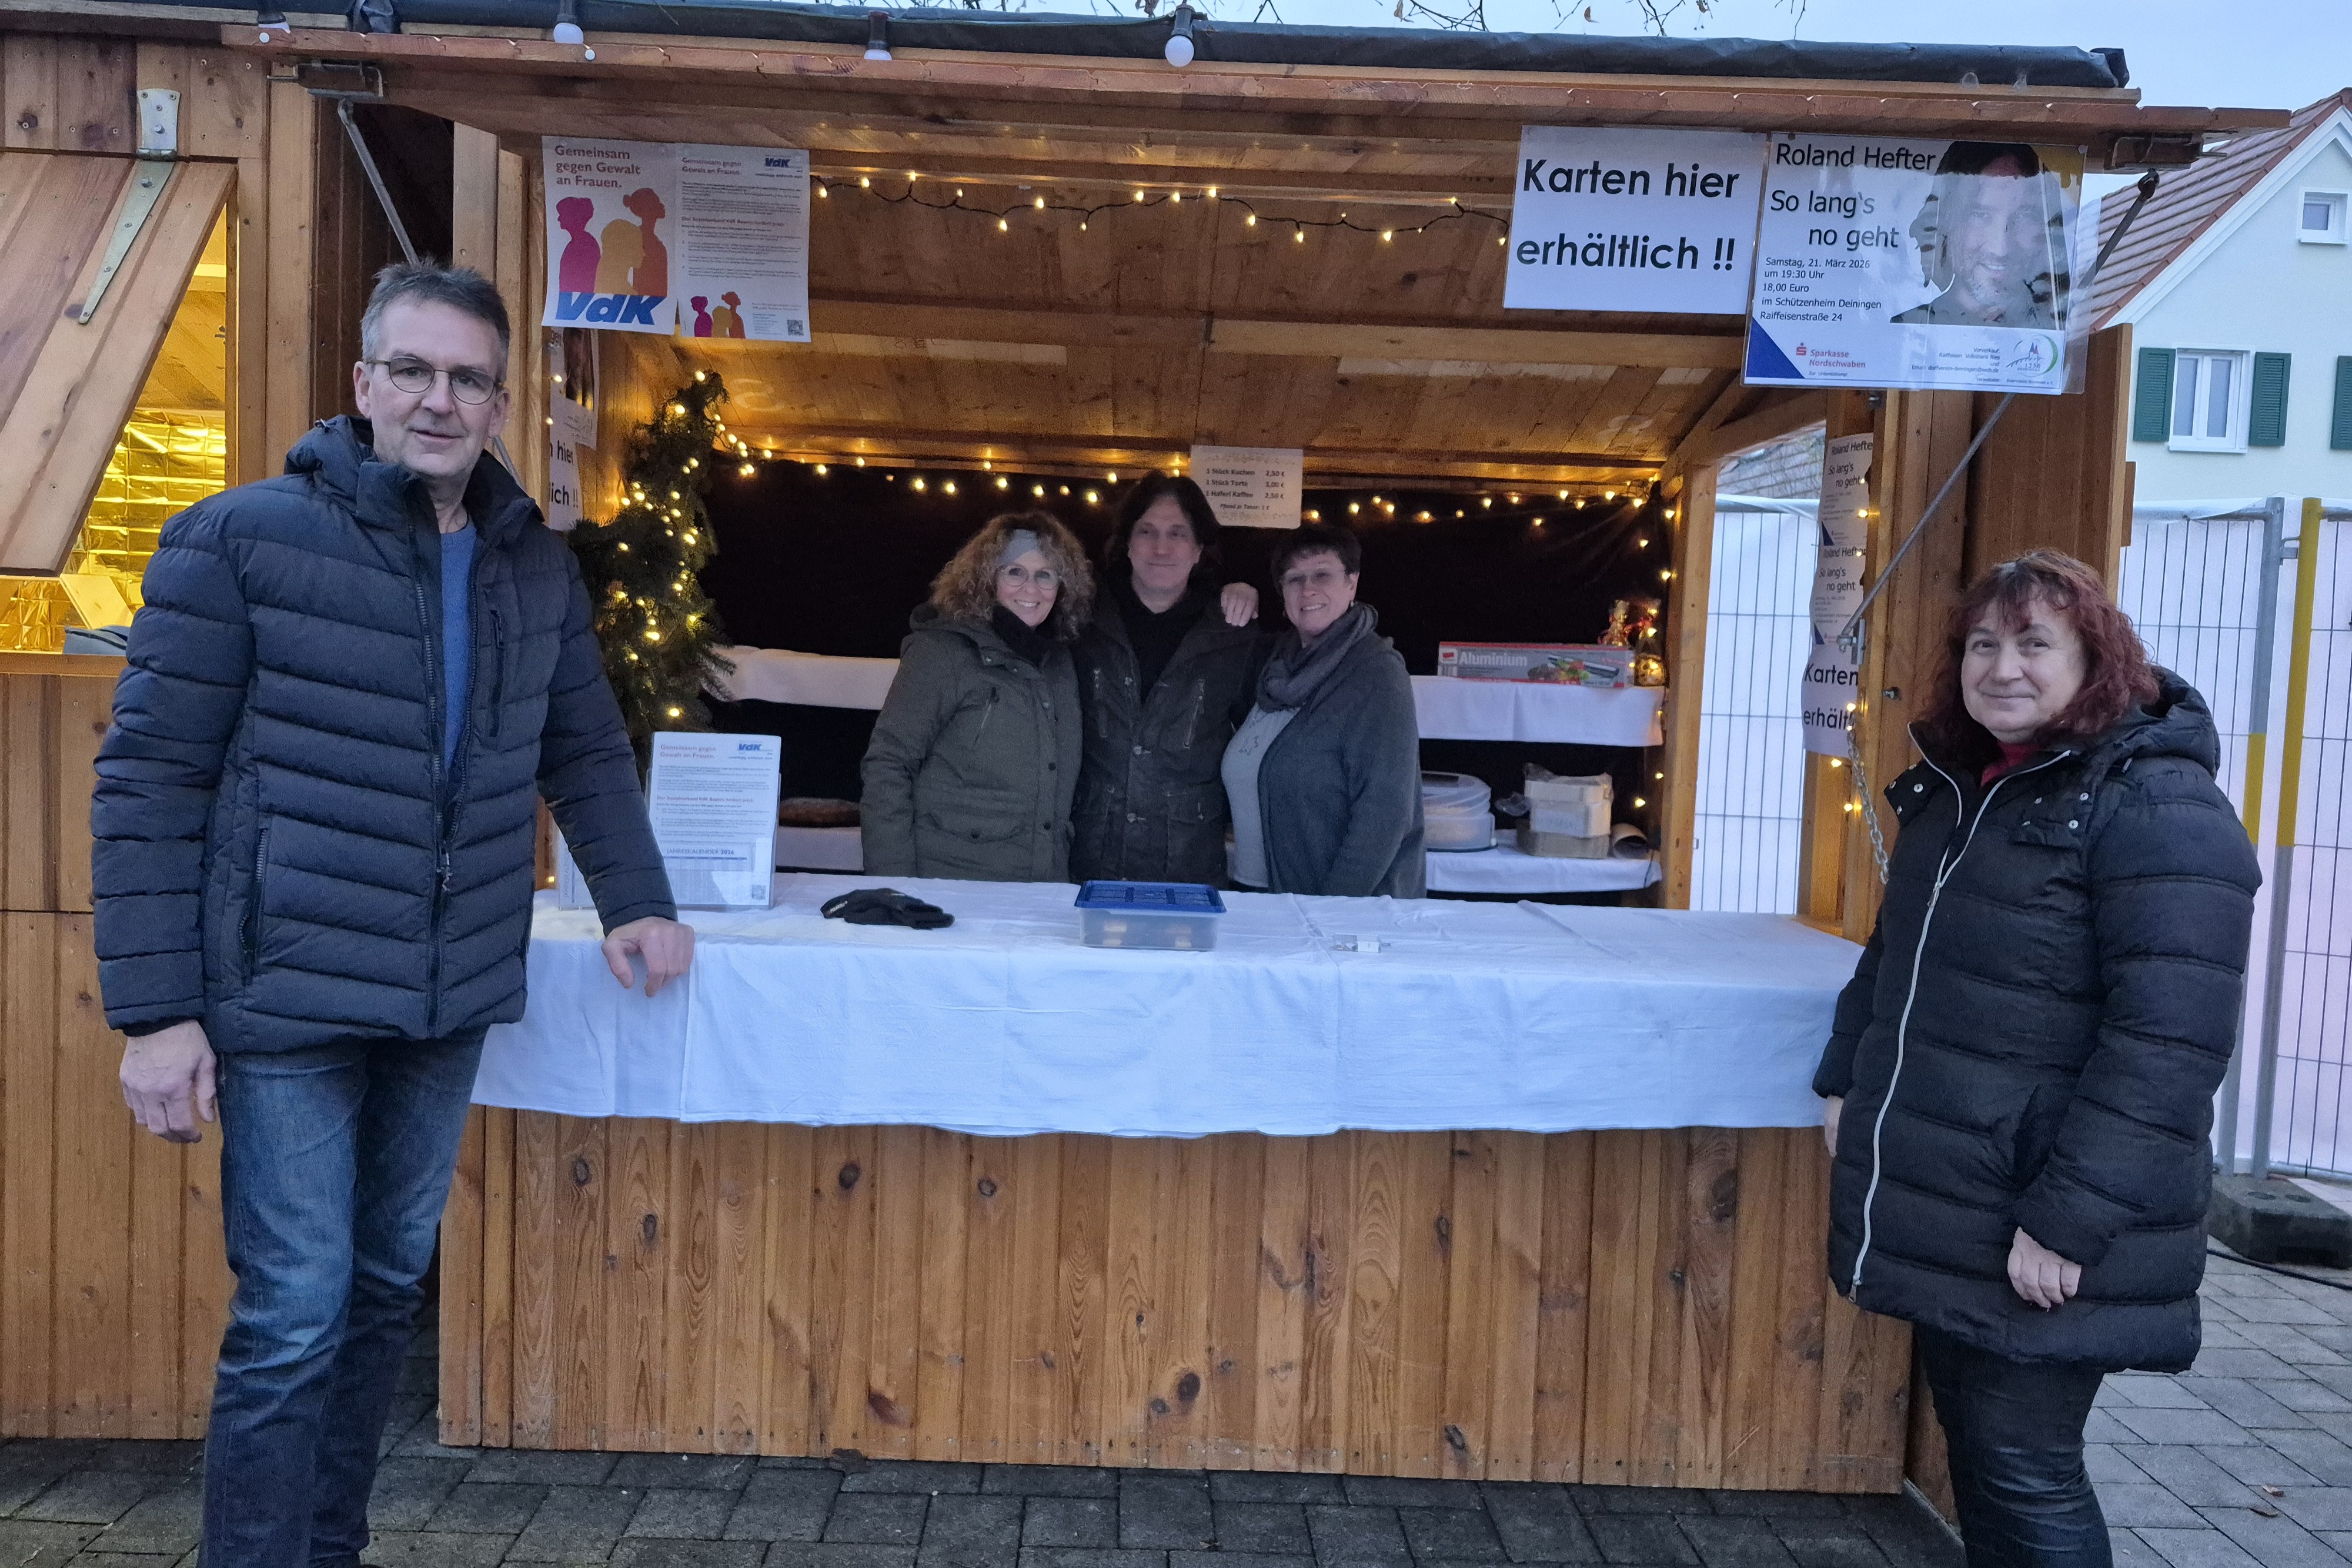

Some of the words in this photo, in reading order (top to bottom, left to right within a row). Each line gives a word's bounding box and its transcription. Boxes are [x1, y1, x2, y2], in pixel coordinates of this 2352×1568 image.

[554, 145, 630, 159] Gemeinsam
[1776, 143, 1855, 167] Roland
[1864, 146, 1936, 170] Hefter
[556, 162, 592, 174] gegen
[596, 162, 640, 175] Gewalt
[765, 158, 790, 168] VdK
[556, 176, 571, 185] an
[575, 175, 622, 188] Frauen.
[1524, 159, 1650, 195] Karten
[1665, 163, 1740, 198] hier
[1770, 190, 1799, 212] So
[1808, 190, 1875, 218] lang's
[1808, 228, 1838, 245] no
[1846, 225, 1899, 251] geht
[1516, 232, 1699, 269] erhältlich
[1713, 238, 1735, 271] !!
[1766, 258, 1805, 268] Samstag,
[1808, 258, 1821, 268] 21.
[1825, 259, 1846, 268] März
[1849, 259, 1870, 268] 2026
[1782, 270, 1806, 278] 19:30
[1809, 270, 1825, 279] Uhr
[1763, 283, 1786, 293] 18,00
[1789, 284, 1809, 292] Euro
[555, 290, 667, 326] VdK
[1775, 297, 1835, 307] Schützenheim
[1839, 299, 1882, 310] Deiningen
[1760, 312, 1829, 321] Raiffeisenstraße
[1832, 313, 1842, 322] 24
[1810, 349, 1849, 358] Sparkasse
[1809, 359, 1866, 368] Nordschwaben
[1850, 440, 1873, 452] Hefte
[1837, 581, 1856, 593] geht
[1459, 651, 1528, 666] Aluminium
[1804, 663, 1859, 686] Karten
[739, 743, 763, 751] VdK
